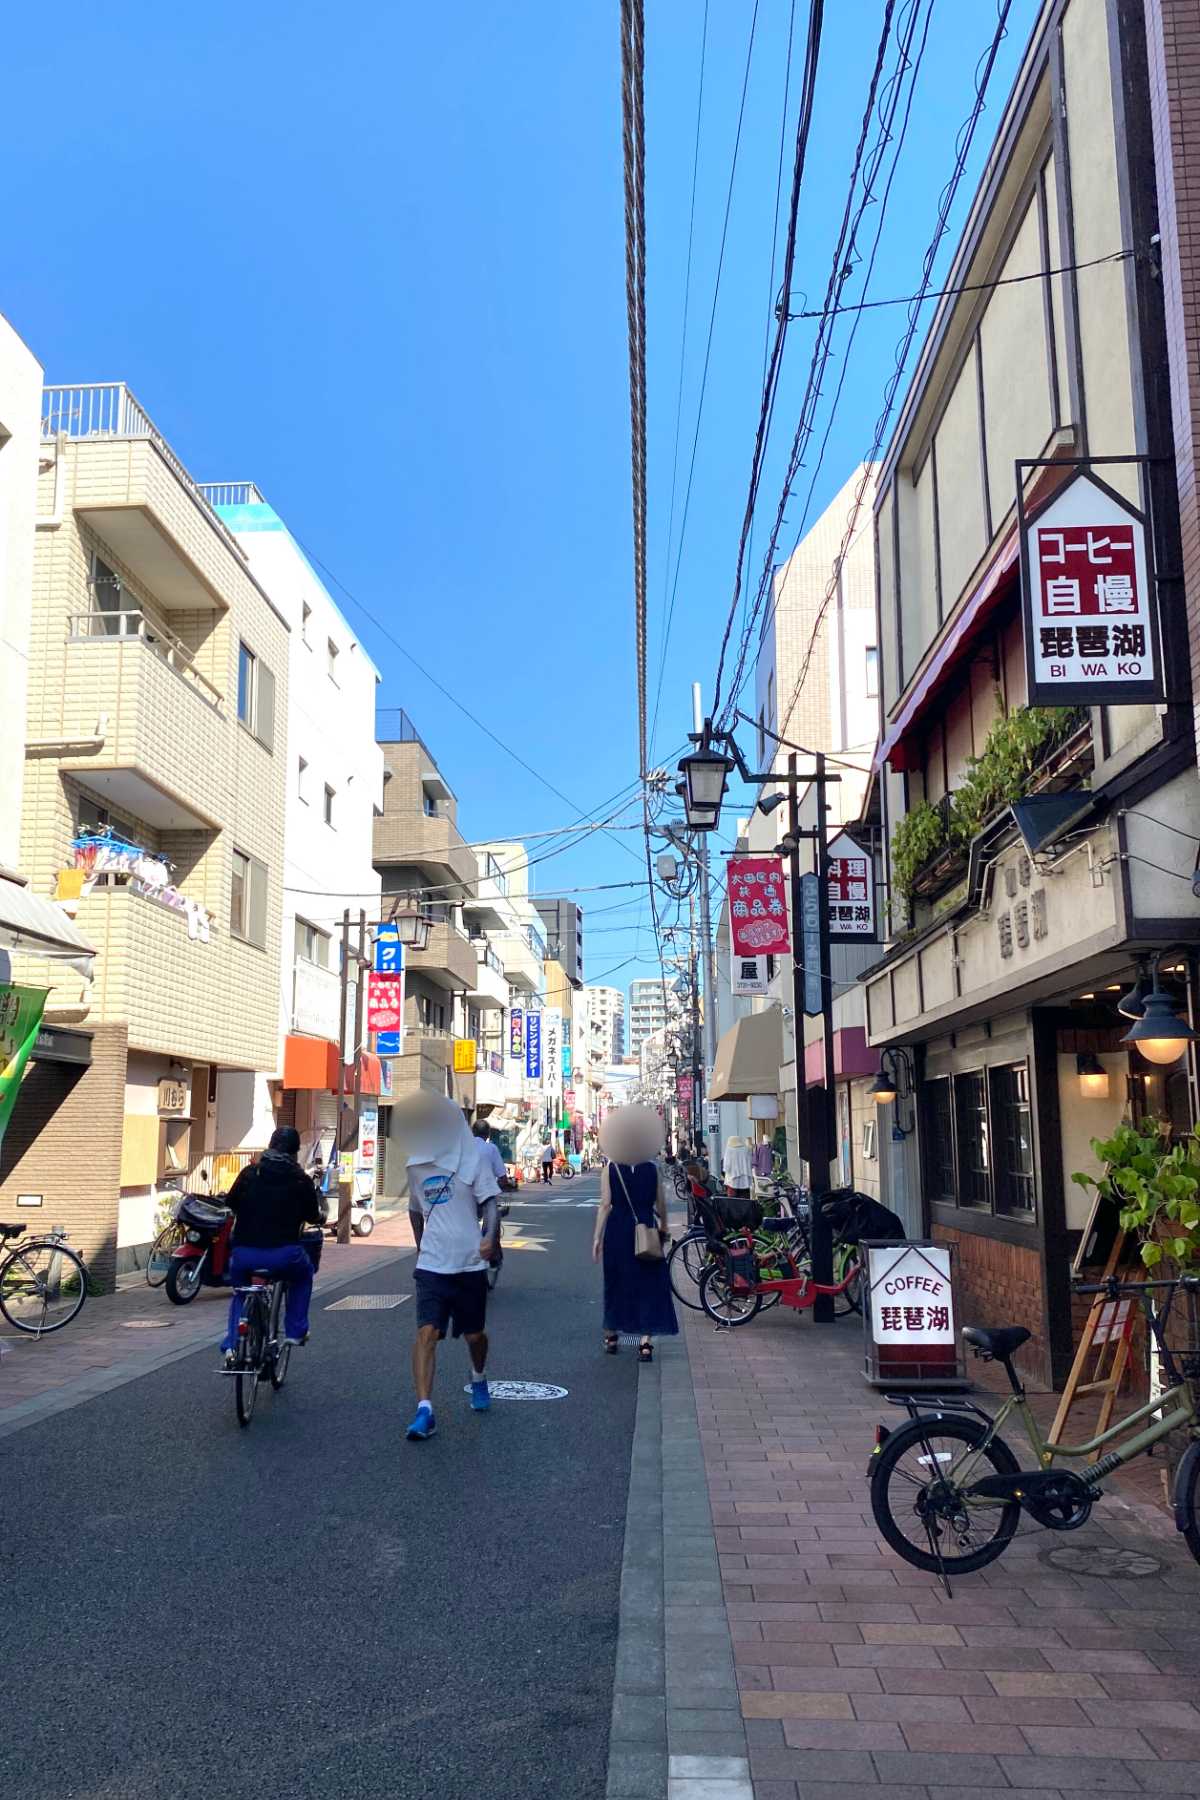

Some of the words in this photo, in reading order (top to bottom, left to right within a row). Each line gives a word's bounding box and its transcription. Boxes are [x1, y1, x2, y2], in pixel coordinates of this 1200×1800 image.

[1040, 531, 1132, 564] コーヒー
[1046, 574, 1135, 614] 自慢
[1039, 624, 1145, 659] 琵琶湖
[529, 1016, 538, 1077] リビングセンター
[547, 1027, 556, 1088] メガネスーパー
[884, 1275, 944, 1297] COFFEE
[880, 1305, 950, 1331] 琵琶湖
